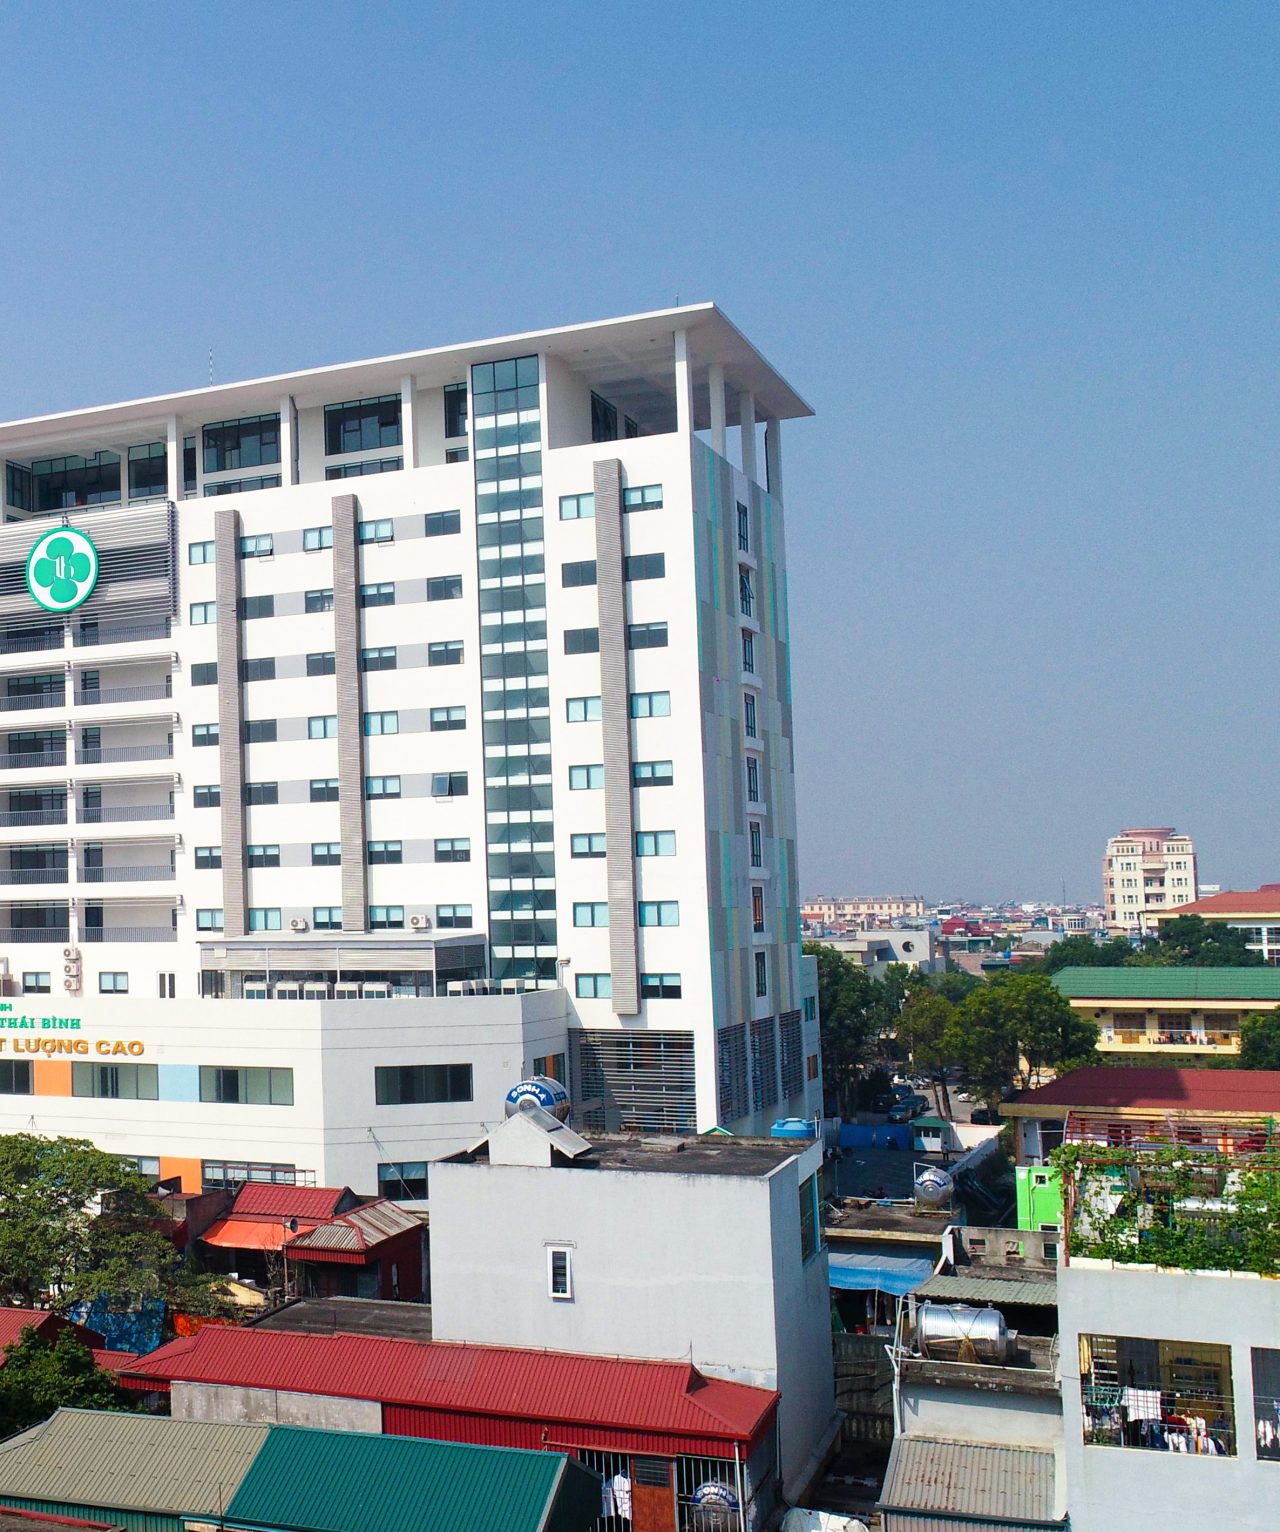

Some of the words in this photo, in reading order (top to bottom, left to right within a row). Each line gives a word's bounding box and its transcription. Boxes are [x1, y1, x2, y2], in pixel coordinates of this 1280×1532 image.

[41, 1015, 81, 1029] BÌNH
[13, 1037, 89, 1058] LƯỢNG
[95, 1040, 145, 1056] CAO
